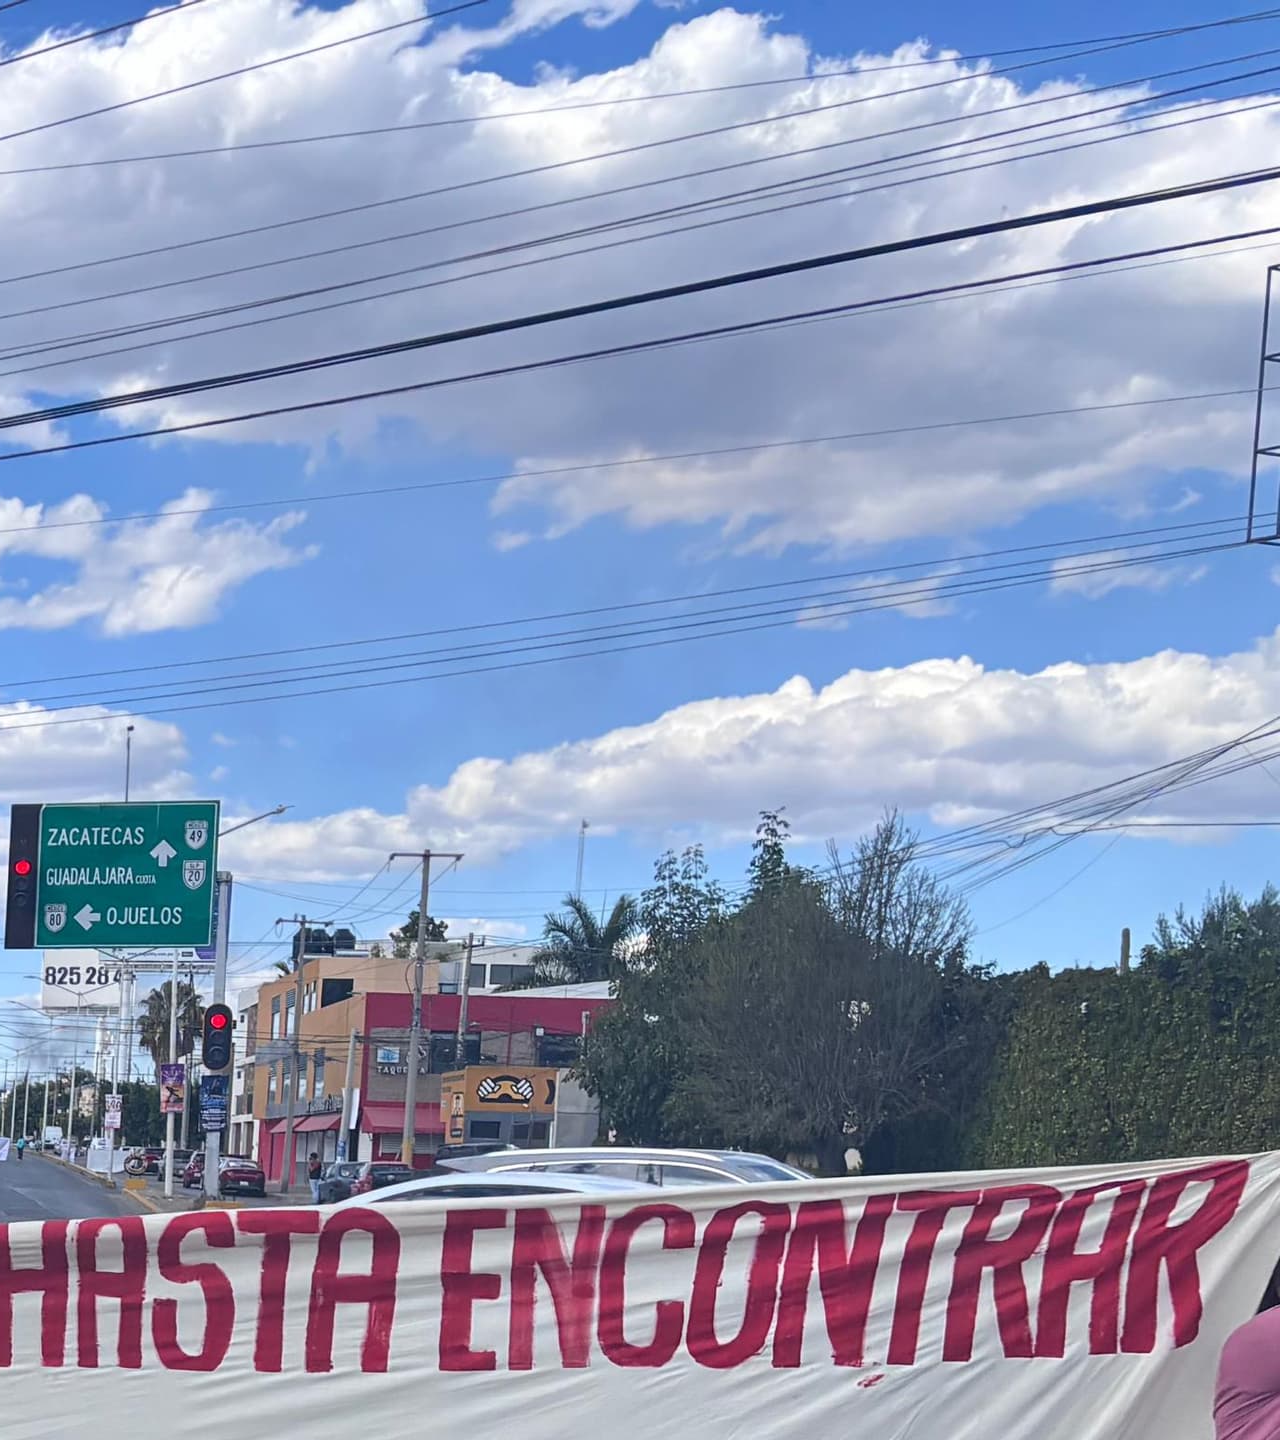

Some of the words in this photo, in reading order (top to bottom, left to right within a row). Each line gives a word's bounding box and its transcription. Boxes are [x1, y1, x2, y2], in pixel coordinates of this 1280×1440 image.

[47, 827, 145, 846] ZACATECAS
[189, 829, 203, 842] 49
[46, 867, 134, 885] GUADALAJARA
[135, 874, 156, 885] CUOTA
[188, 869, 201, 881] 20
[49, 913, 62, 926] 80
[106, 907, 182, 925] OJUELOS
[45, 966, 81, 985] 825
[85, 966, 109, 985] 28
[377, 1066, 425, 1075] TAQUEA
[438, 1158, 1252, 1373] ENCONTRAR
